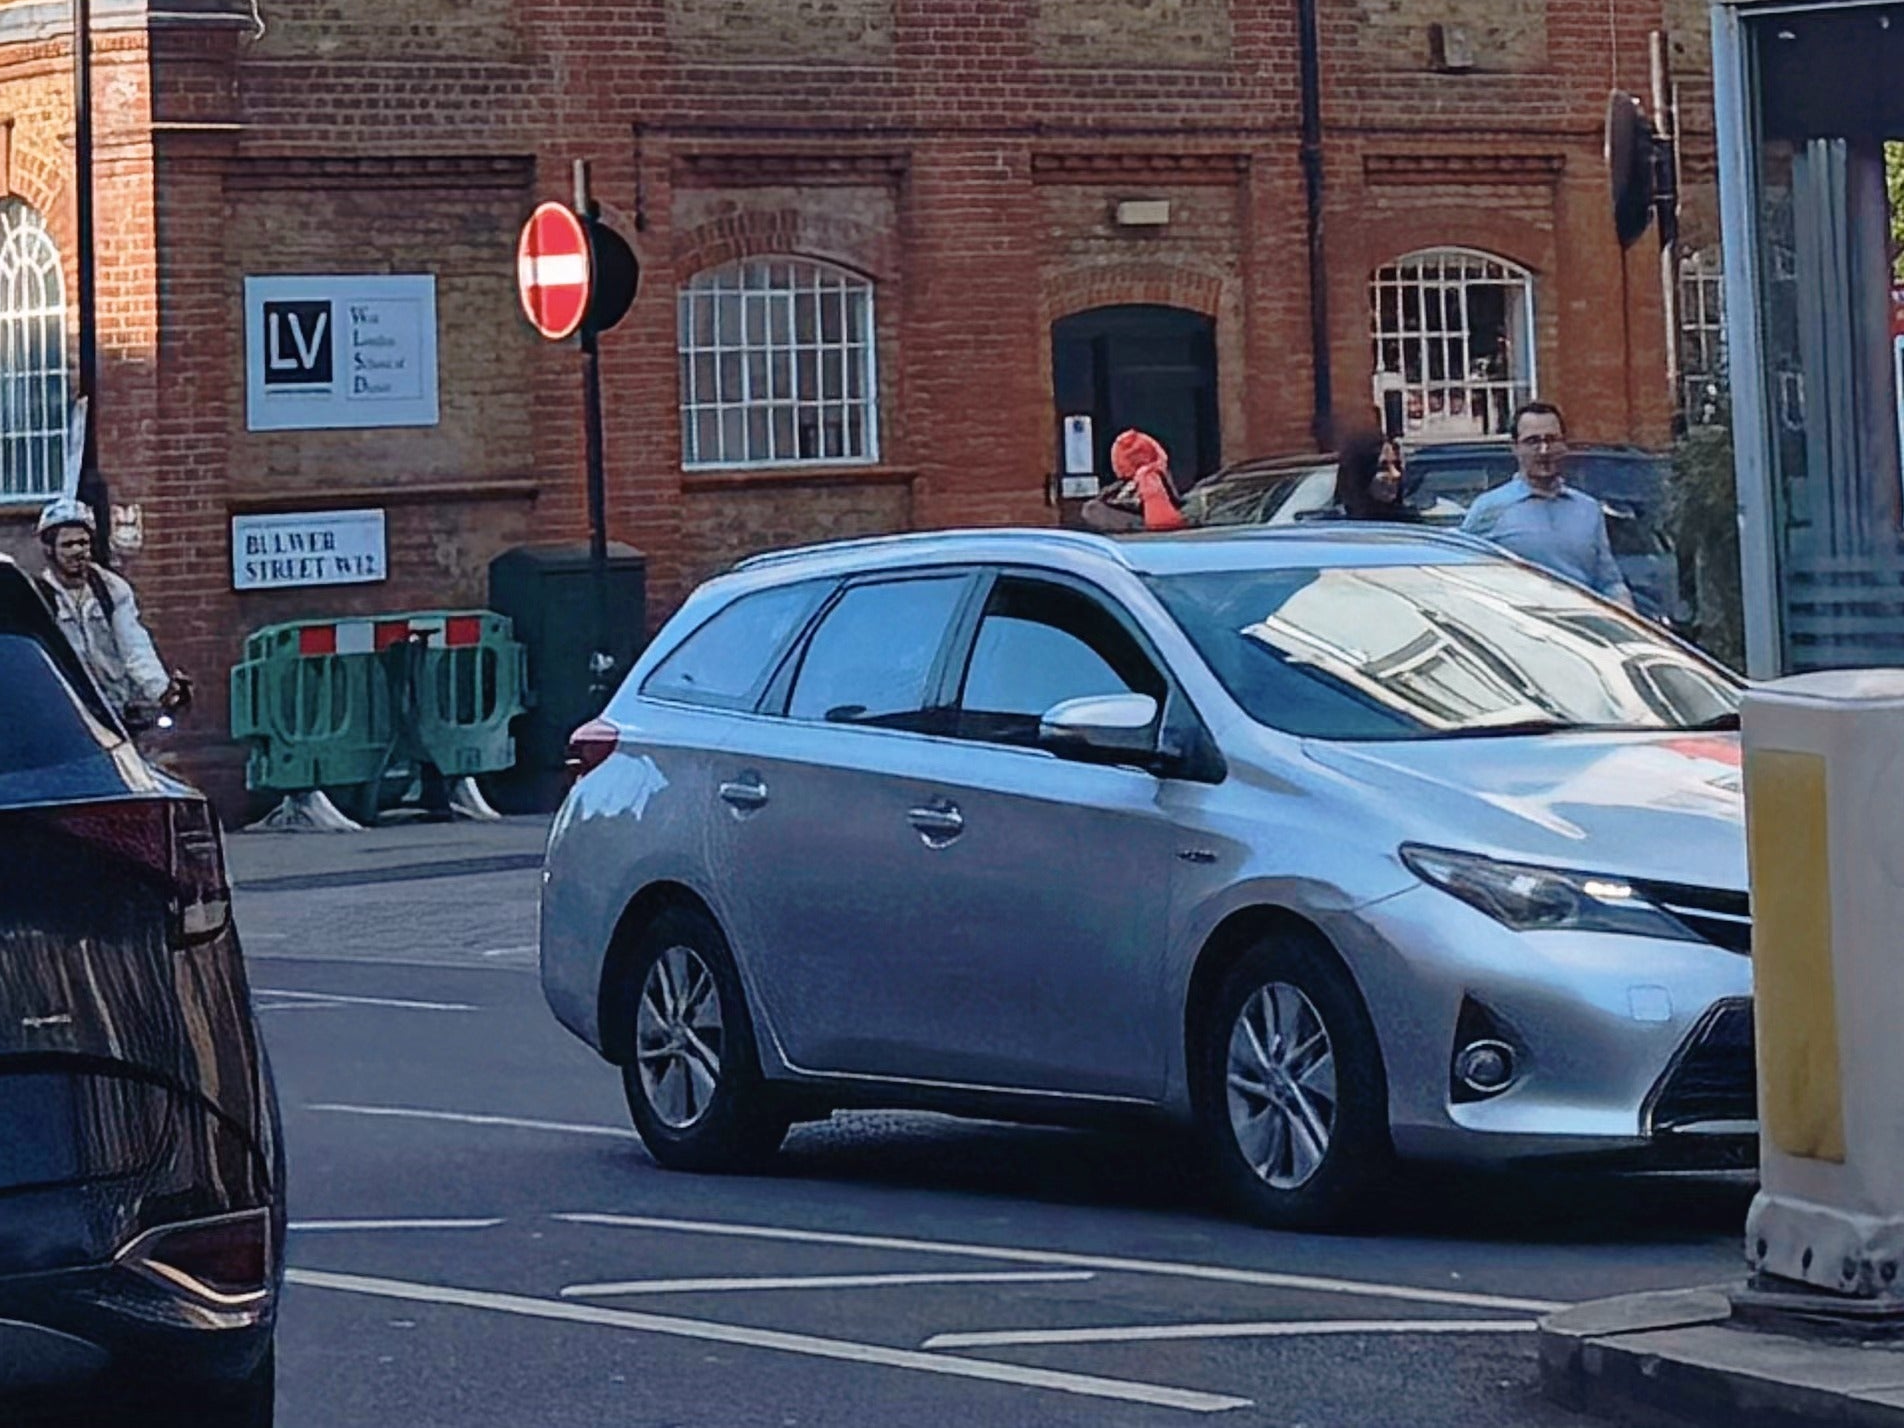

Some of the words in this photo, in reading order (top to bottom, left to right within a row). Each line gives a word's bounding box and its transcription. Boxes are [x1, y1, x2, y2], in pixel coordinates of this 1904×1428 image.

[268, 311, 328, 370] LV
[246, 556, 325, 581] STREET
[334, 554, 378, 576] W12
